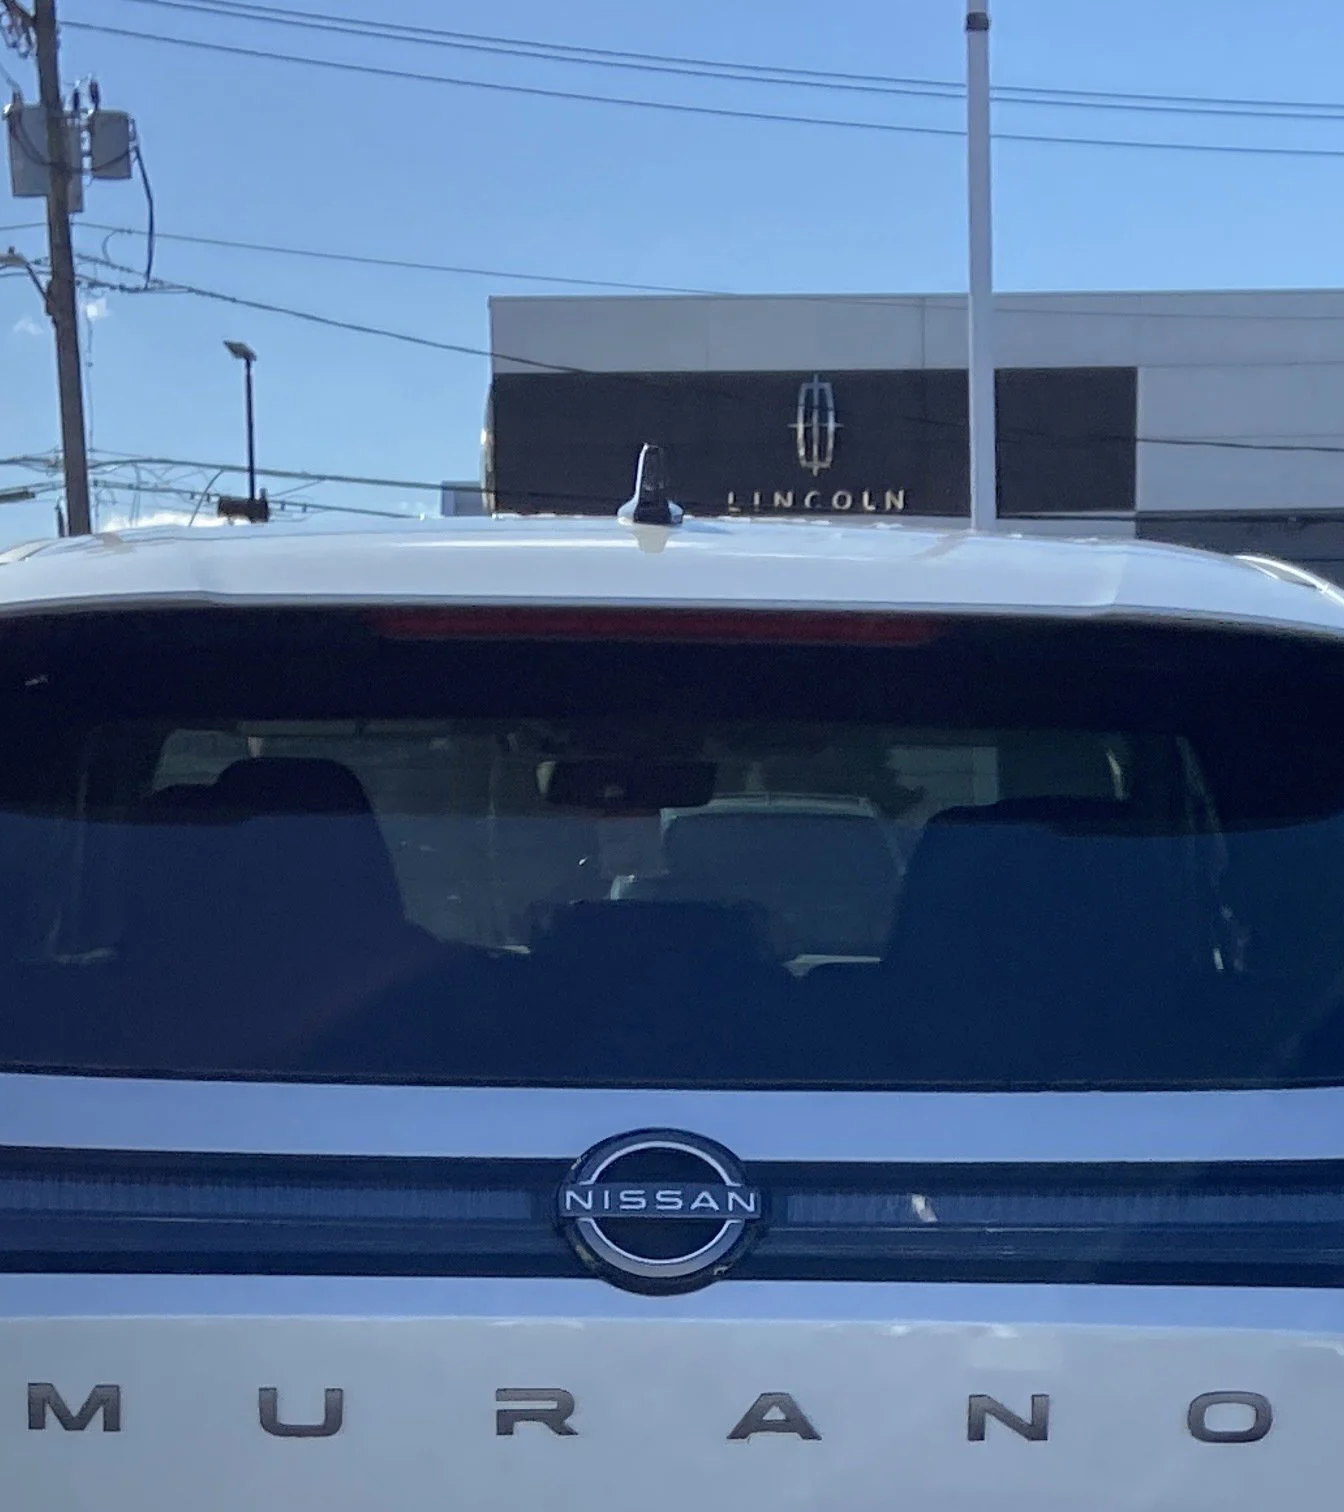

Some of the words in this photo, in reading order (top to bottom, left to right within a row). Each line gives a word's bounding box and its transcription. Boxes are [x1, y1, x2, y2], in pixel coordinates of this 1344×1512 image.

[728, 489, 905, 511] LINCOLN
[565, 1190, 755, 1212] NISSAN
[27, 1382, 1273, 1442] MURANO
